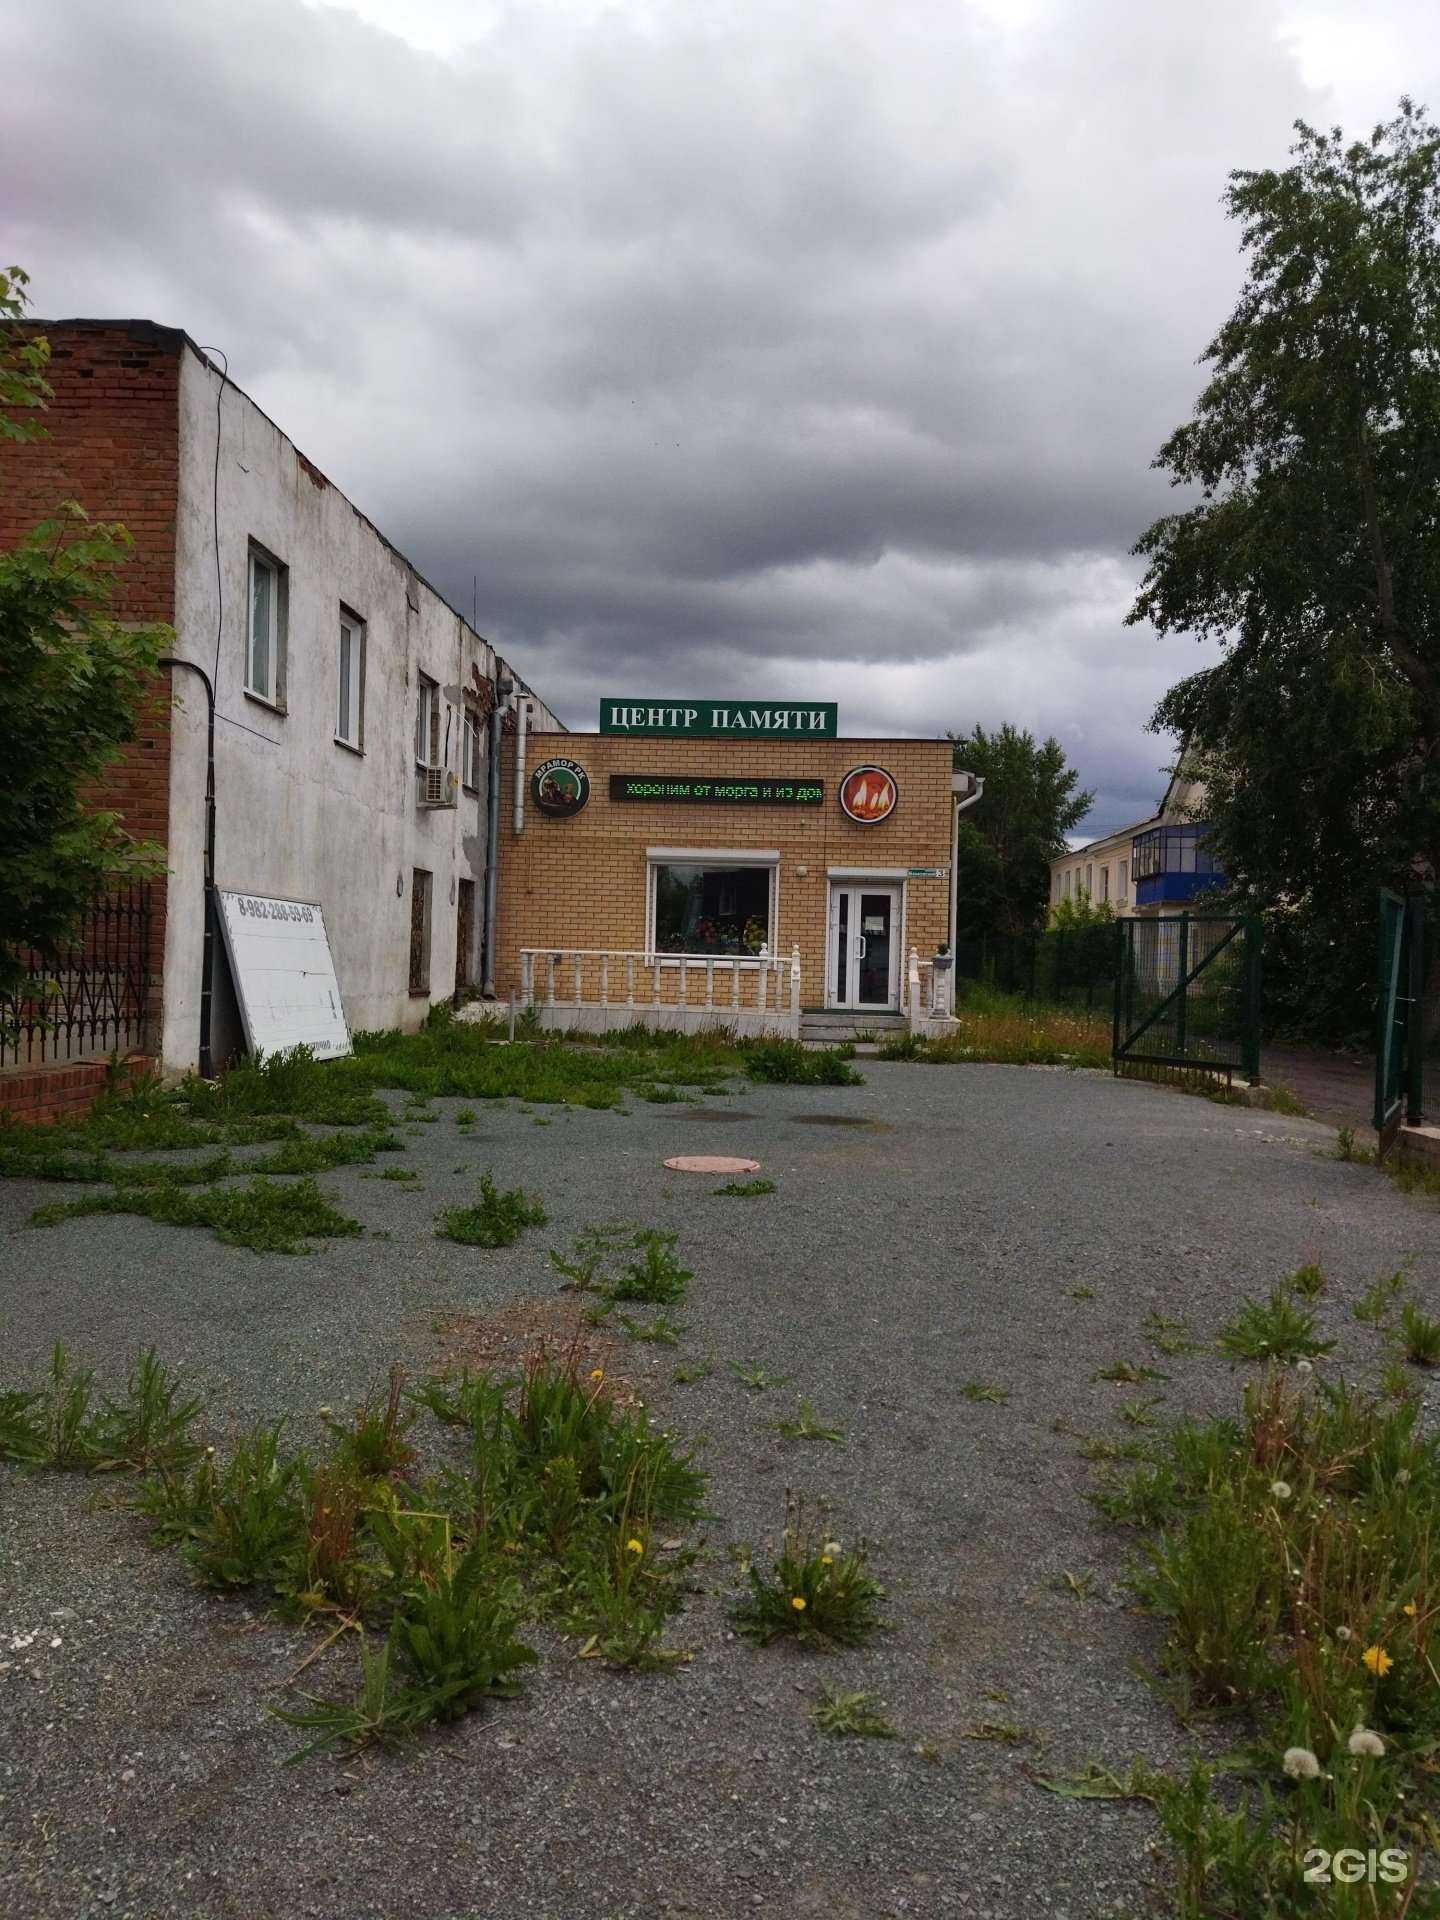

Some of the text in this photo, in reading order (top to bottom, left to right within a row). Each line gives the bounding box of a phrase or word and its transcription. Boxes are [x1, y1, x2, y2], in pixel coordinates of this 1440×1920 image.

[610, 707, 828, 732] ЦЕНТР ПАМЯТИ
[535, 759, 574, 779] МРАМОР
[775, 787, 793, 798] из
